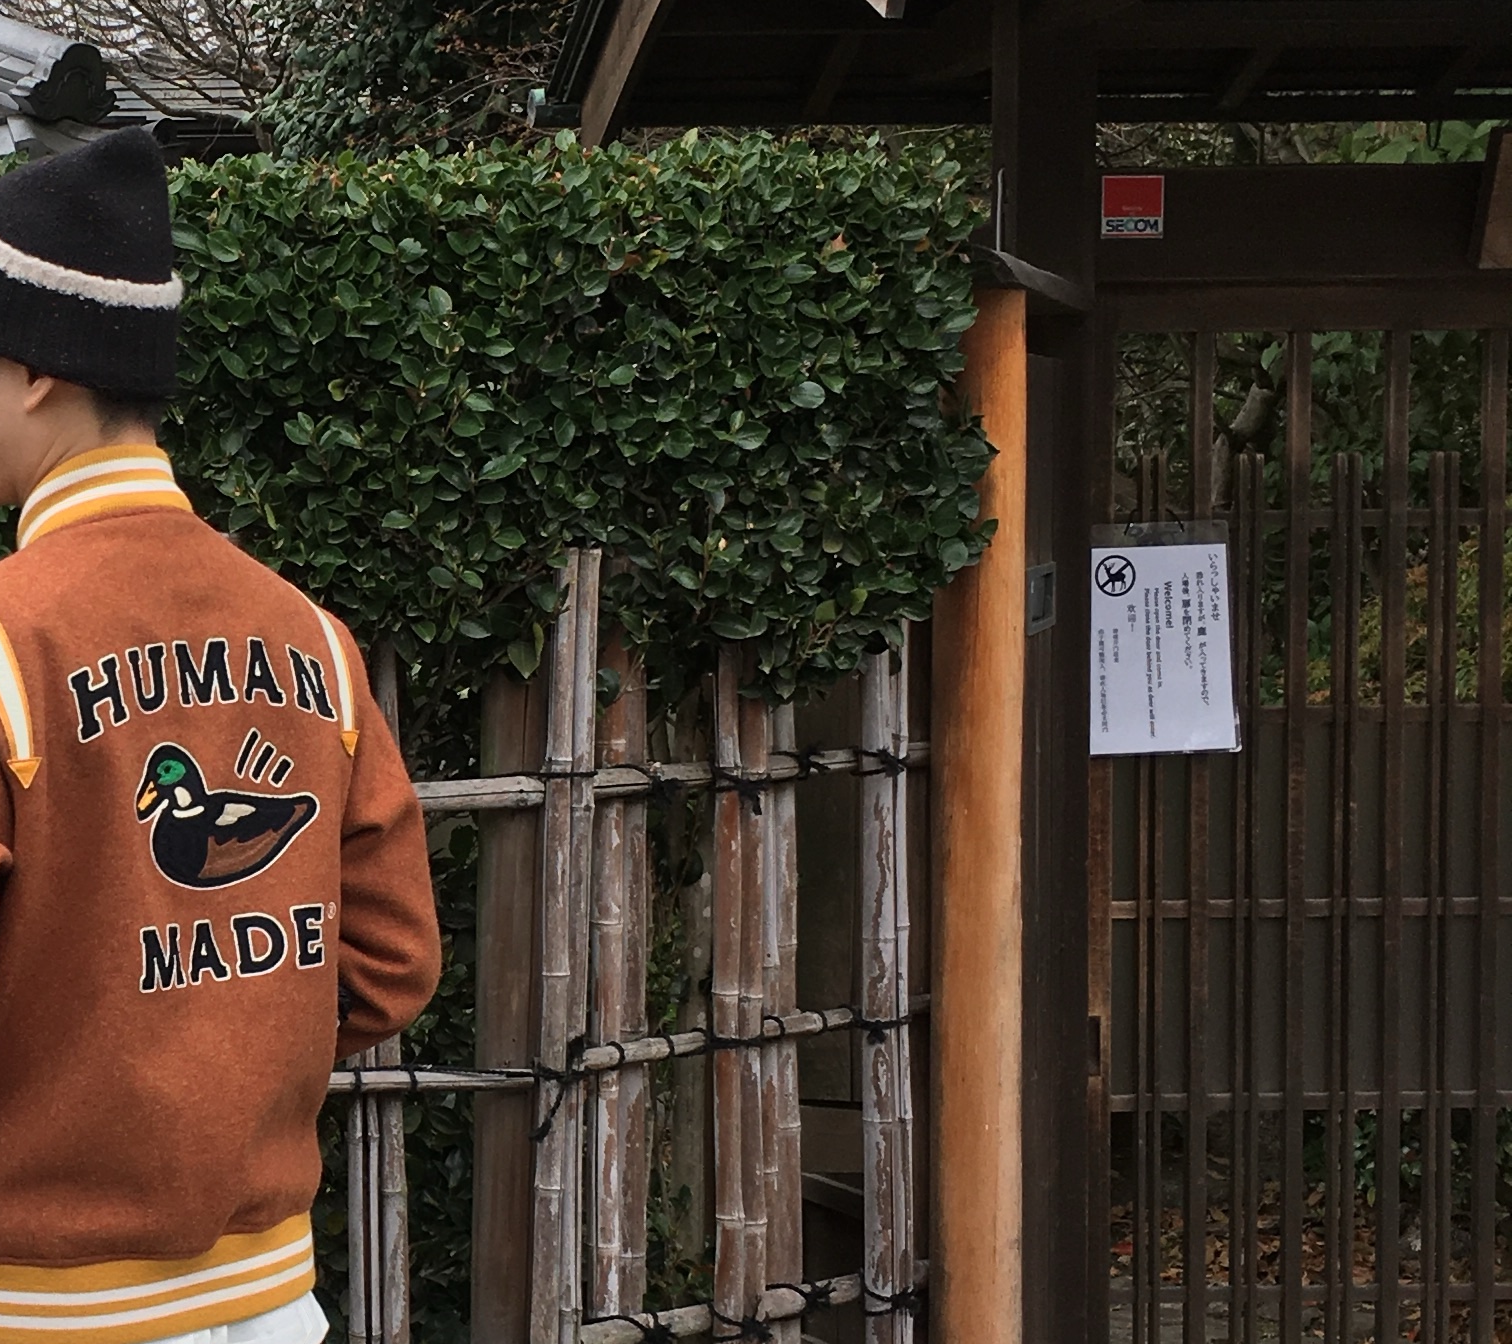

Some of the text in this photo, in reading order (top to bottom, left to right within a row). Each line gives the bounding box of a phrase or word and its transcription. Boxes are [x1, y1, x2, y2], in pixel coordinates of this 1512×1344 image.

[1106, 219, 1159, 233] SECOM
[1208, 553, 1221, 621] いらっしゃいませ
[67, 636, 338, 743] HUMAN
[139, 902, 326, 994] MADE
